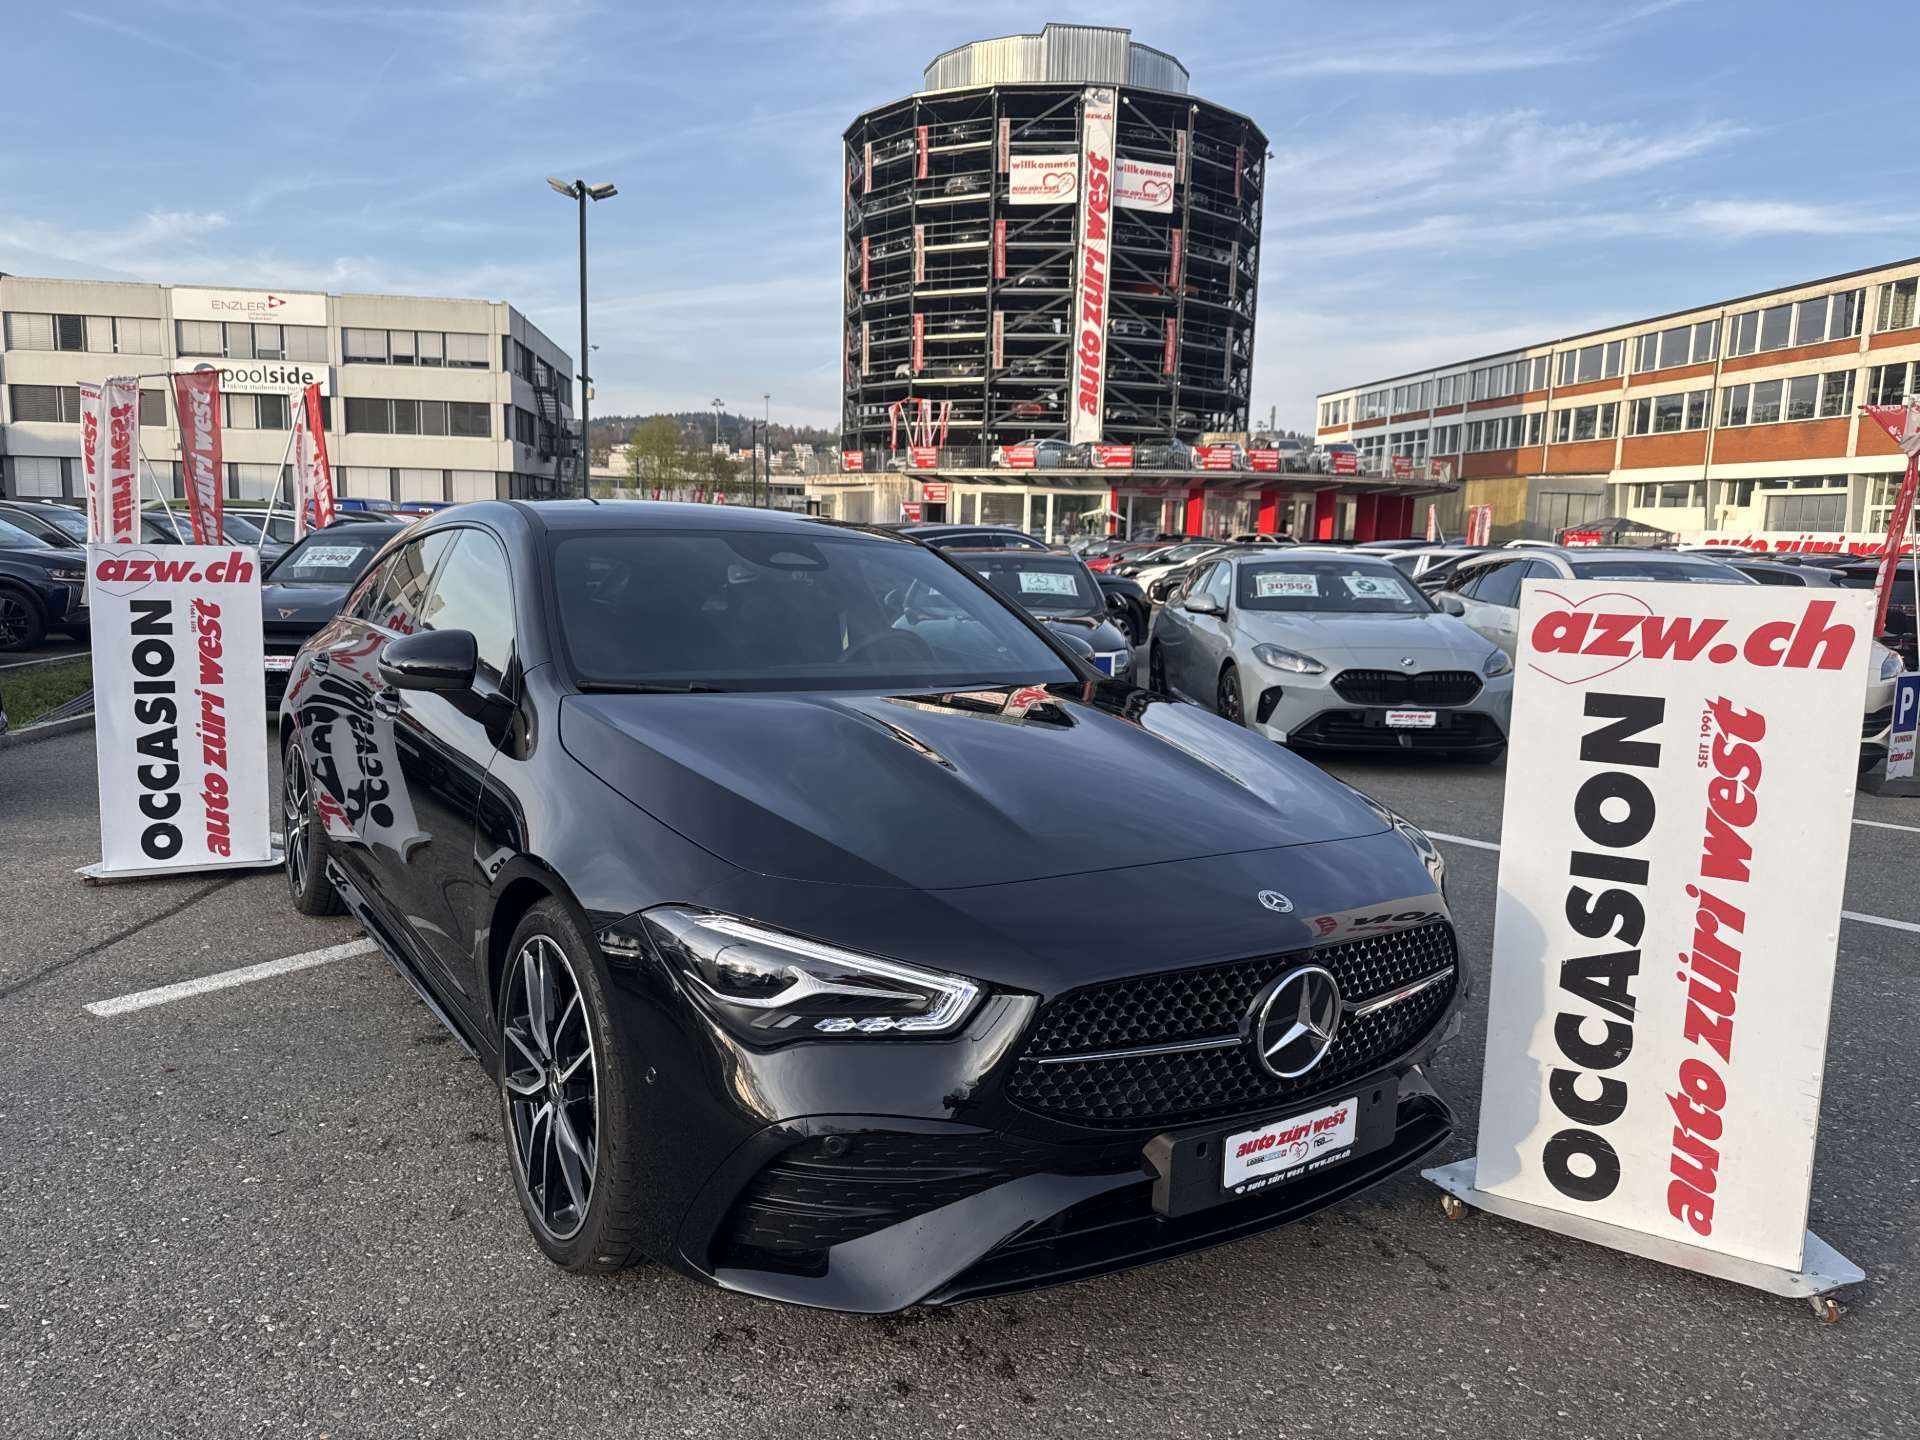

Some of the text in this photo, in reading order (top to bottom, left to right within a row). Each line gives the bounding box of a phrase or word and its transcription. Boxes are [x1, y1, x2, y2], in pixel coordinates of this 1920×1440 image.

[1012, 160, 1076, 169] willkommen
[1116, 163, 1173, 178] willkommen
[211, 300, 265, 311] ENZLER
[1079, 150, 1109, 416] auto züri west
[222, 365, 314, 388] poolside
[191, 387, 213, 450] west
[95, 552, 254, 583] azw.ch
[1531, 599, 1856, 670] azw.ch
[129, 599, 183, 861] OCCASION
[191, 597, 231, 858] auto züri west
[1899, 686, 1914, 724] P
[1697, 710, 1713, 768] SEIT 1991
[1542, 691, 1667, 1202] OCCASION
[1665, 695, 1766, 1237] auto züri west
[1236, 1133, 1276, 1158] auto
[1276, 1119, 1313, 1146] züri
[1313, 1108, 1348, 1134] west
[1247, 1179, 1266, 1192] auto
[1286, 1166, 1305, 1178] west
